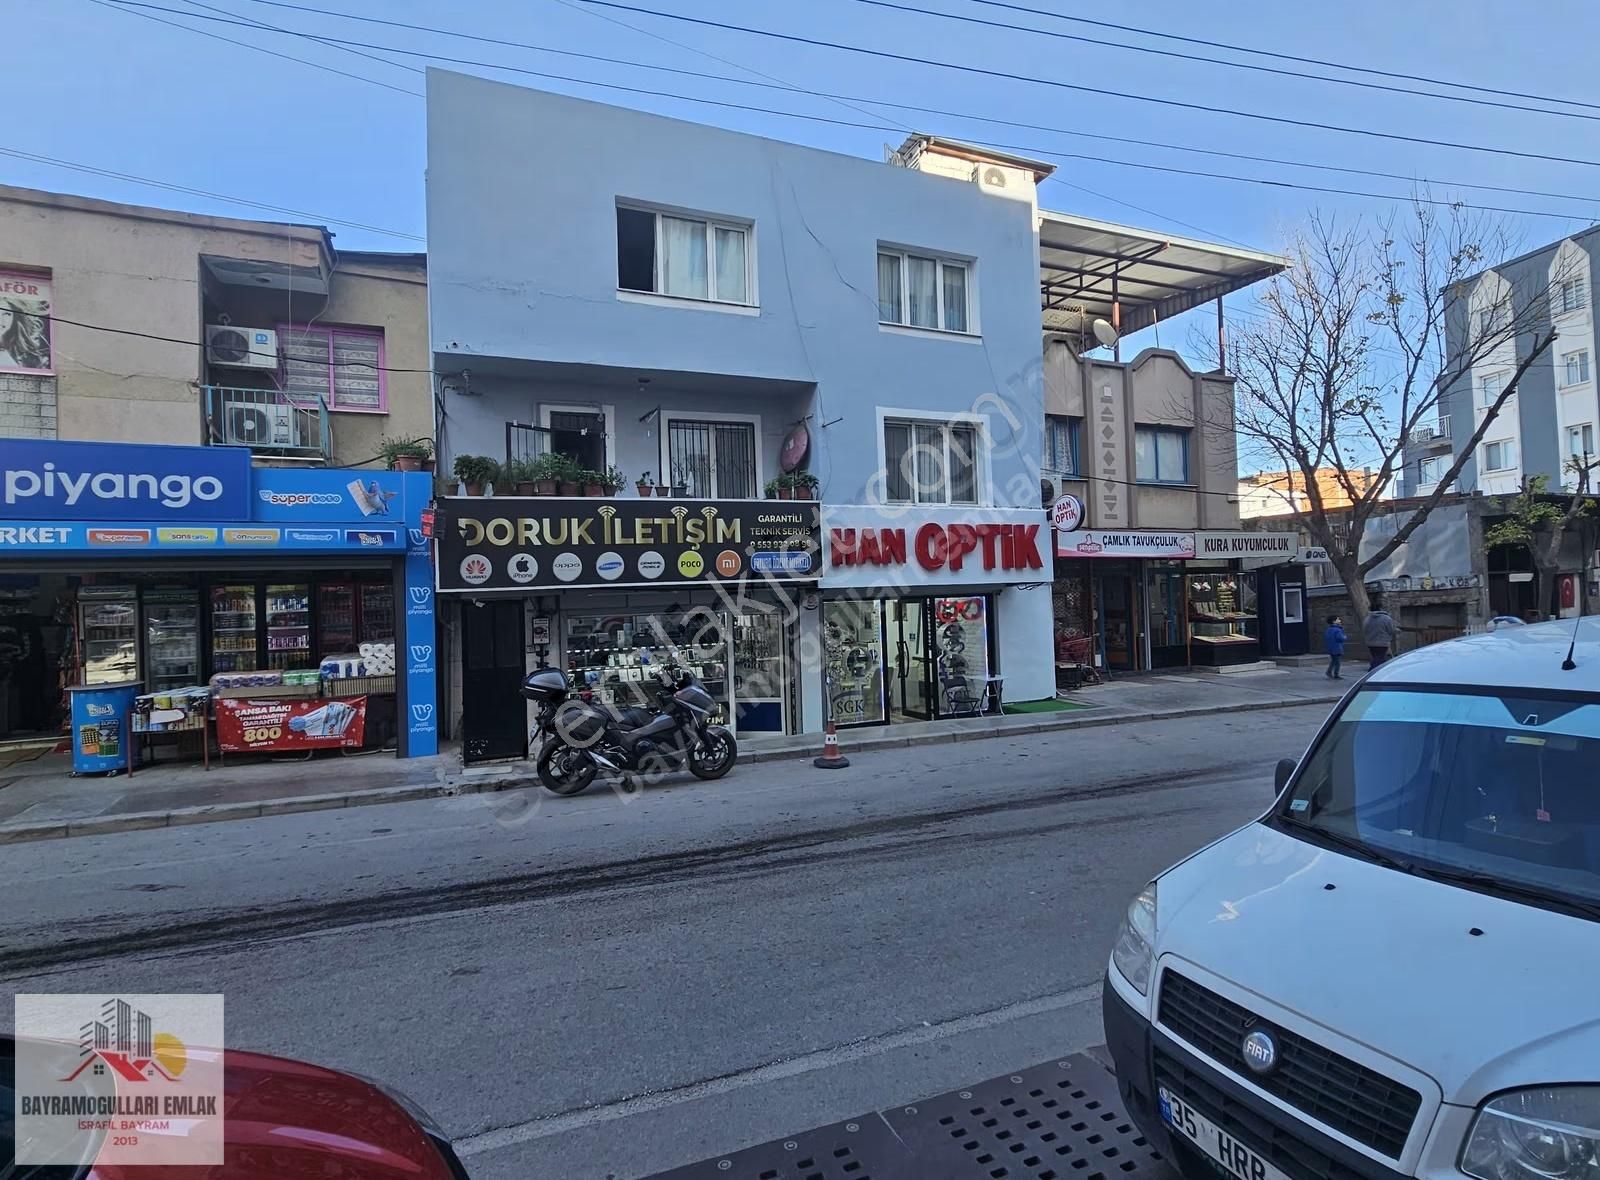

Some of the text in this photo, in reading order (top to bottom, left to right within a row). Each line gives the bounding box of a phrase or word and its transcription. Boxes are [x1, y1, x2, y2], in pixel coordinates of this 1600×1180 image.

[5, 462, 223, 508] piyango
[1056, 500, 1071, 512] HAN
[757, 513, 803, 523] GARANTİLİ
[458, 517, 595, 547] DORUK
[597, 505, 741, 551] İLETİŞİM
[750, 527, 811, 536] TEKNİK SERVİS
[757, 540, 772, 549] 553
[831, 528, 907, 567] HAN
[1102, 535, 1179, 549] ÇAMLIK TAVUKÇULUK
[1204, 537, 1289, 552] KURA KUYUMCULUK
[680, 560, 702, 568] POCO
[836, 699, 865, 714] SGK
[243, 727, 282, 742] 800
[1246, 1040, 1270, 1062] FIAT
[1171, 1097, 1197, 1139] 35
